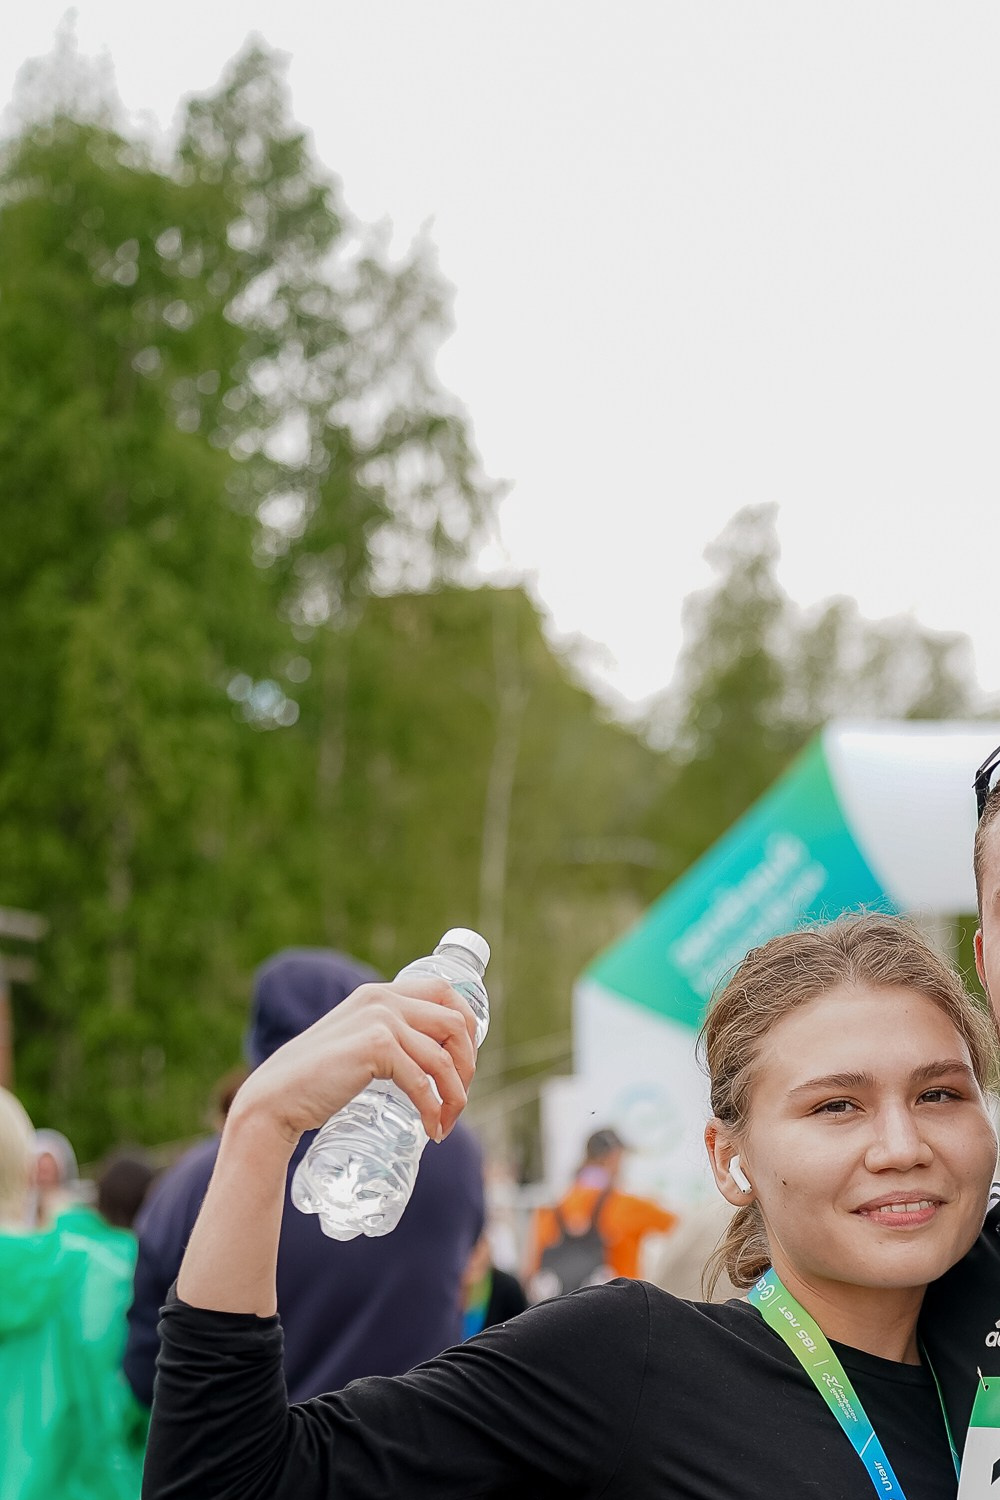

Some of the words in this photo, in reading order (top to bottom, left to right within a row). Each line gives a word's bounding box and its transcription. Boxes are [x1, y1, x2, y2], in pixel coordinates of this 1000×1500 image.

[779, 1306, 800, 1328] лет
[796, 1330, 817, 1354] 185
[874, 1460, 893, 1491] Utair
